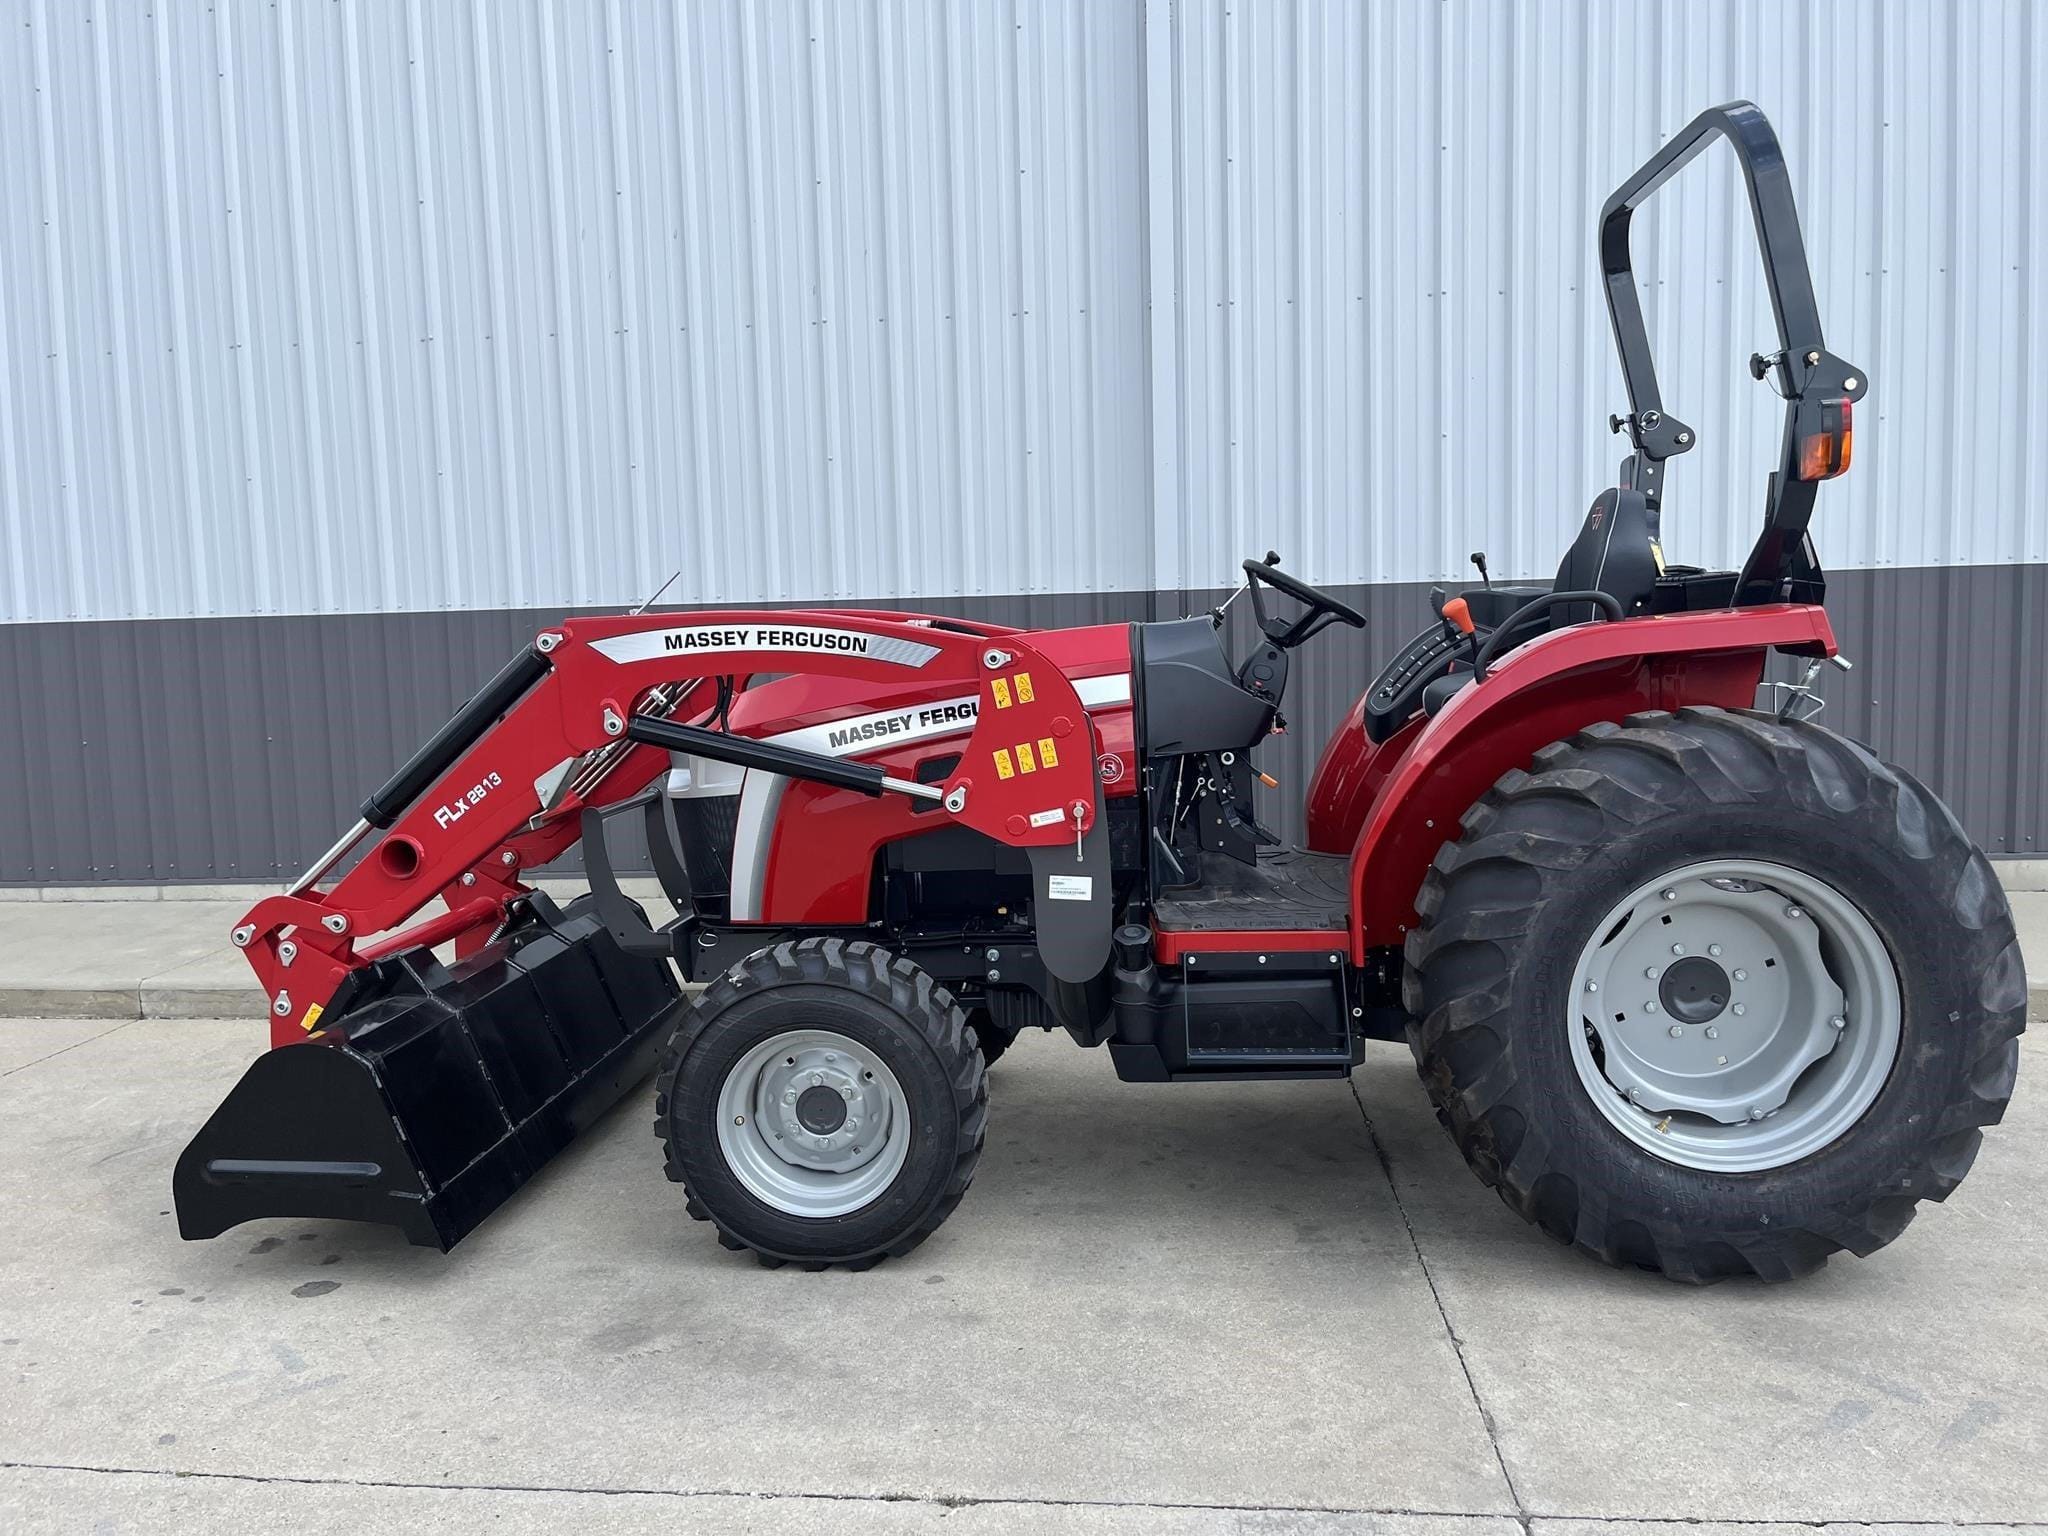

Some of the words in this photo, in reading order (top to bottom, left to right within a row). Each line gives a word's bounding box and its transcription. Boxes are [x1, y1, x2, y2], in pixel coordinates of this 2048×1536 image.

[664, 630, 749, 650] MASSEY
[757, 630, 868, 653] FERGUSON
[828, 714, 912, 748] MASSEY
[466, 771, 502, 805] 2813
